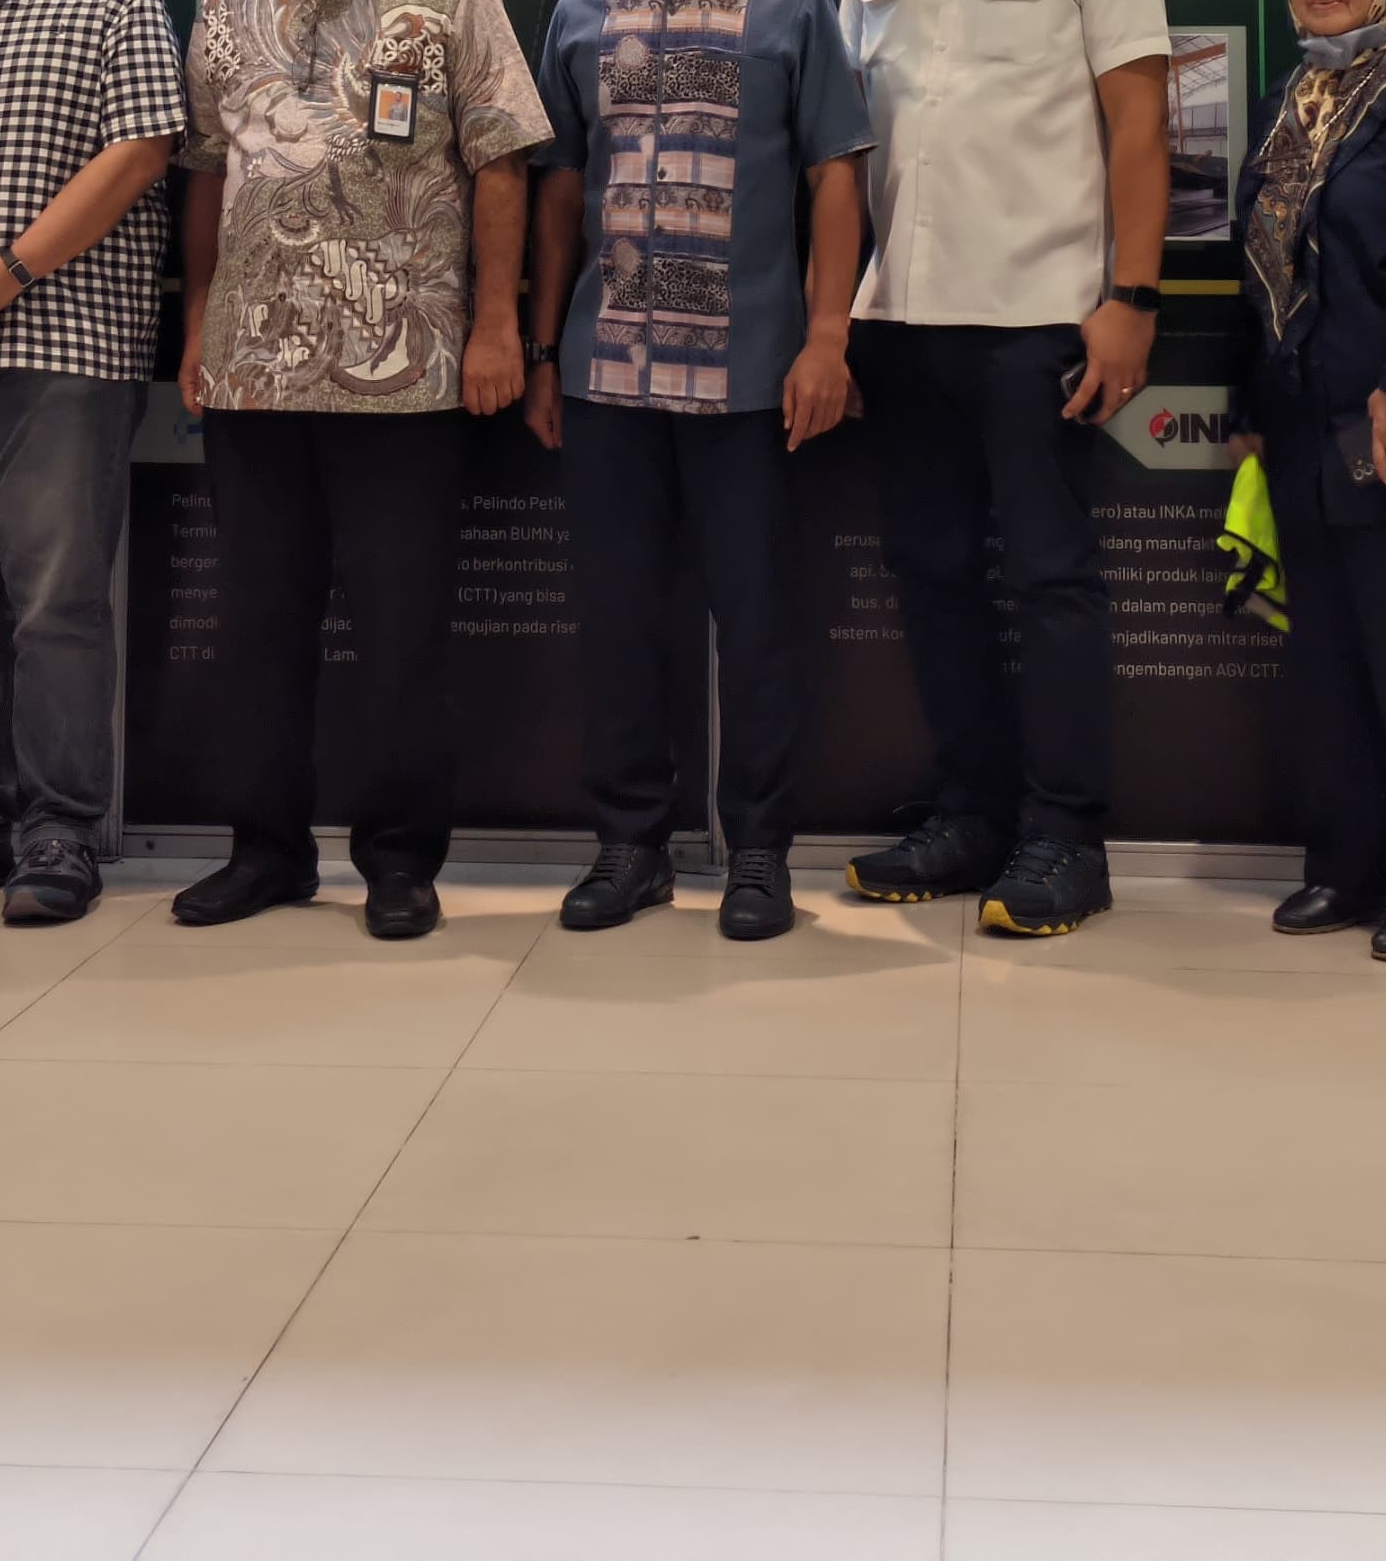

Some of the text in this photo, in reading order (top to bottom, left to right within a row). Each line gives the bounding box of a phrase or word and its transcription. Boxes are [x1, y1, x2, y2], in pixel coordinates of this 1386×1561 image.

[473, 495, 526, 511] Pelindo
[530, 495, 566, 511] Petik
[1124, 504, 1156, 519] atau
[1160, 503, 1197, 519] INKA
[511, 526, 554, 541] BUMN
[1145, 535, 1215, 551] manufakt
[170, 555, 568, 573] berger berkontribusi
[1146, 568, 1199, 585] produk
[170, 587, 566, 606] menye (CTT) yang bisa
[1122, 599, 1166, 615] dalam
[451, 618, 510, 636] engujian
[513, 619, 548, 636] pada
[1207, 632, 1247, 647] mitra
[1250, 632, 1285, 647] riset
[1114, 662, 1214, 679] ngembangan
[1215, 662, 1247, 678] AGV
